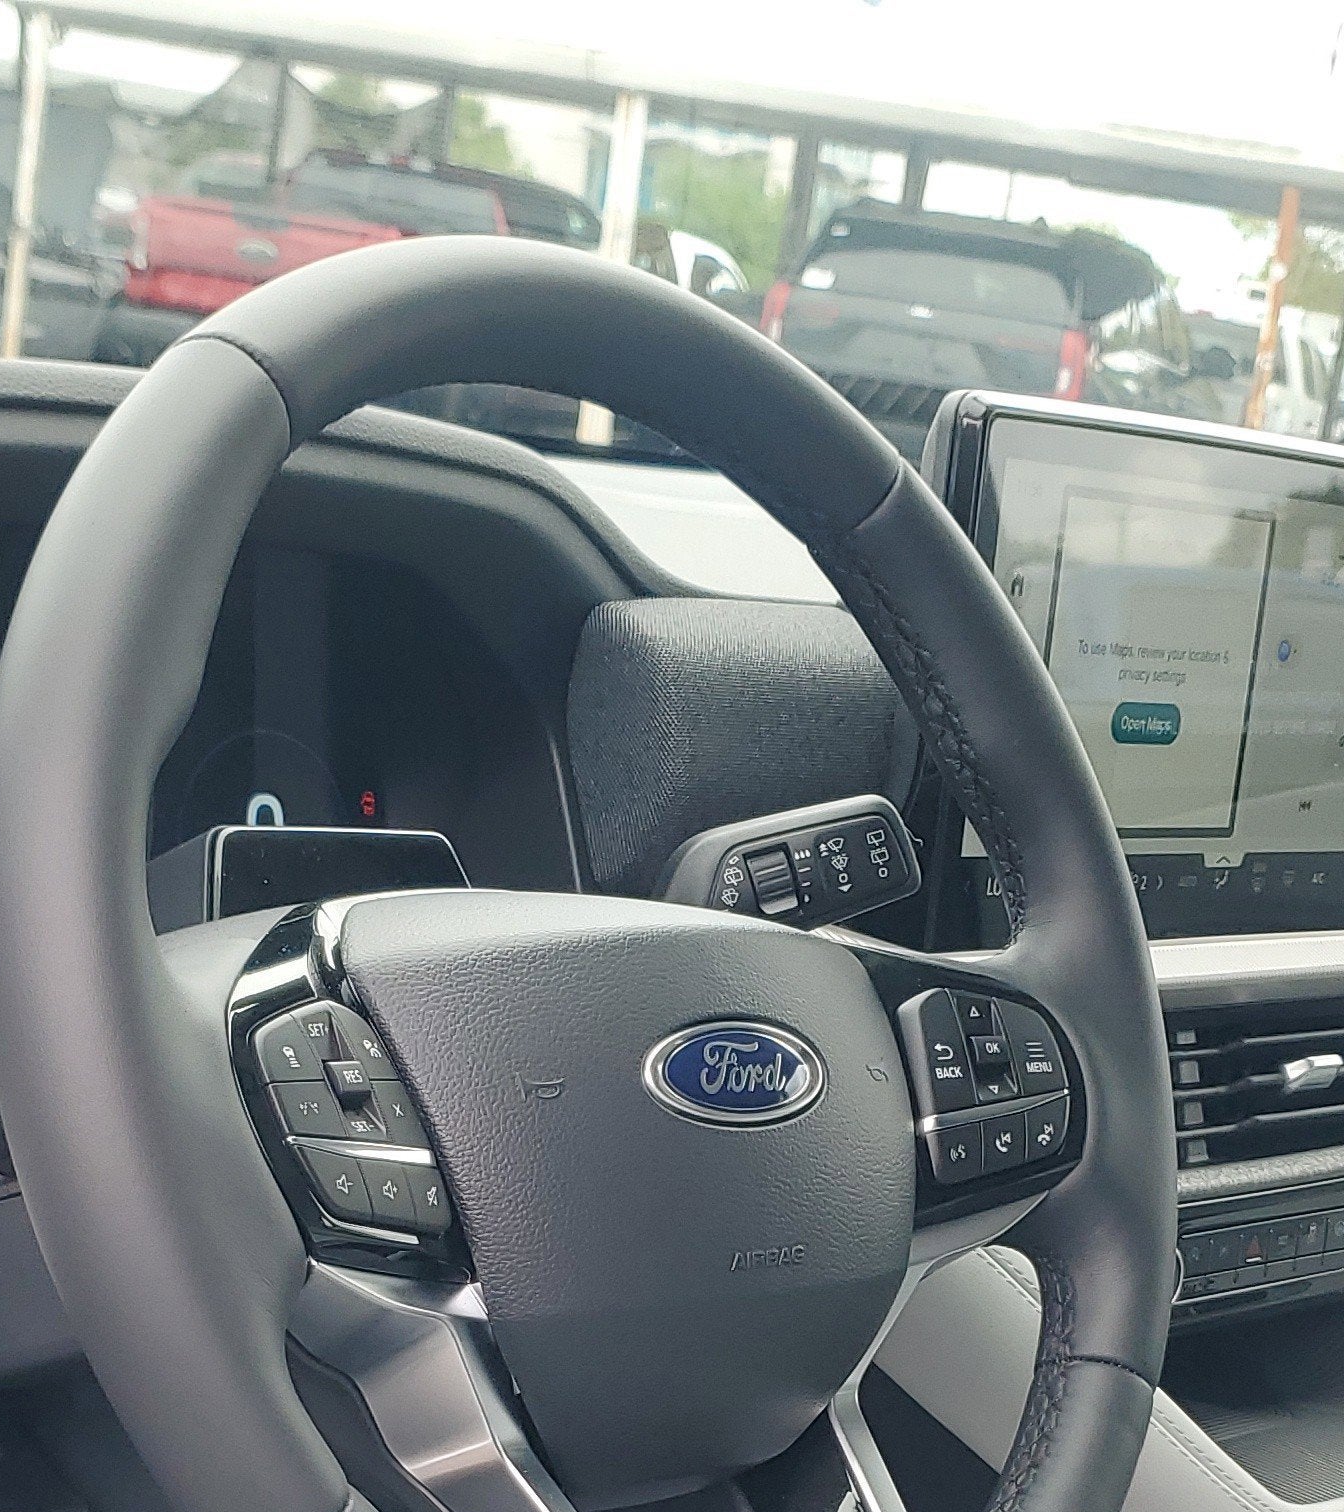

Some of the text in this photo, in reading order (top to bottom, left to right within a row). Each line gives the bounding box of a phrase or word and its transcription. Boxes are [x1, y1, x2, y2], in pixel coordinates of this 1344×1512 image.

[1120, 715, 1147, 735] Open
[985, 1042, 1001, 1054] OK
[700, 1041, 787, 1095] Ford
[935, 1066, 964, 1080] BACK
[1025, 1061, 1053, 1073] MENU
[342, 1069, 363, 1084] RES
[729, 1244, 806, 1271] AIRBAG
